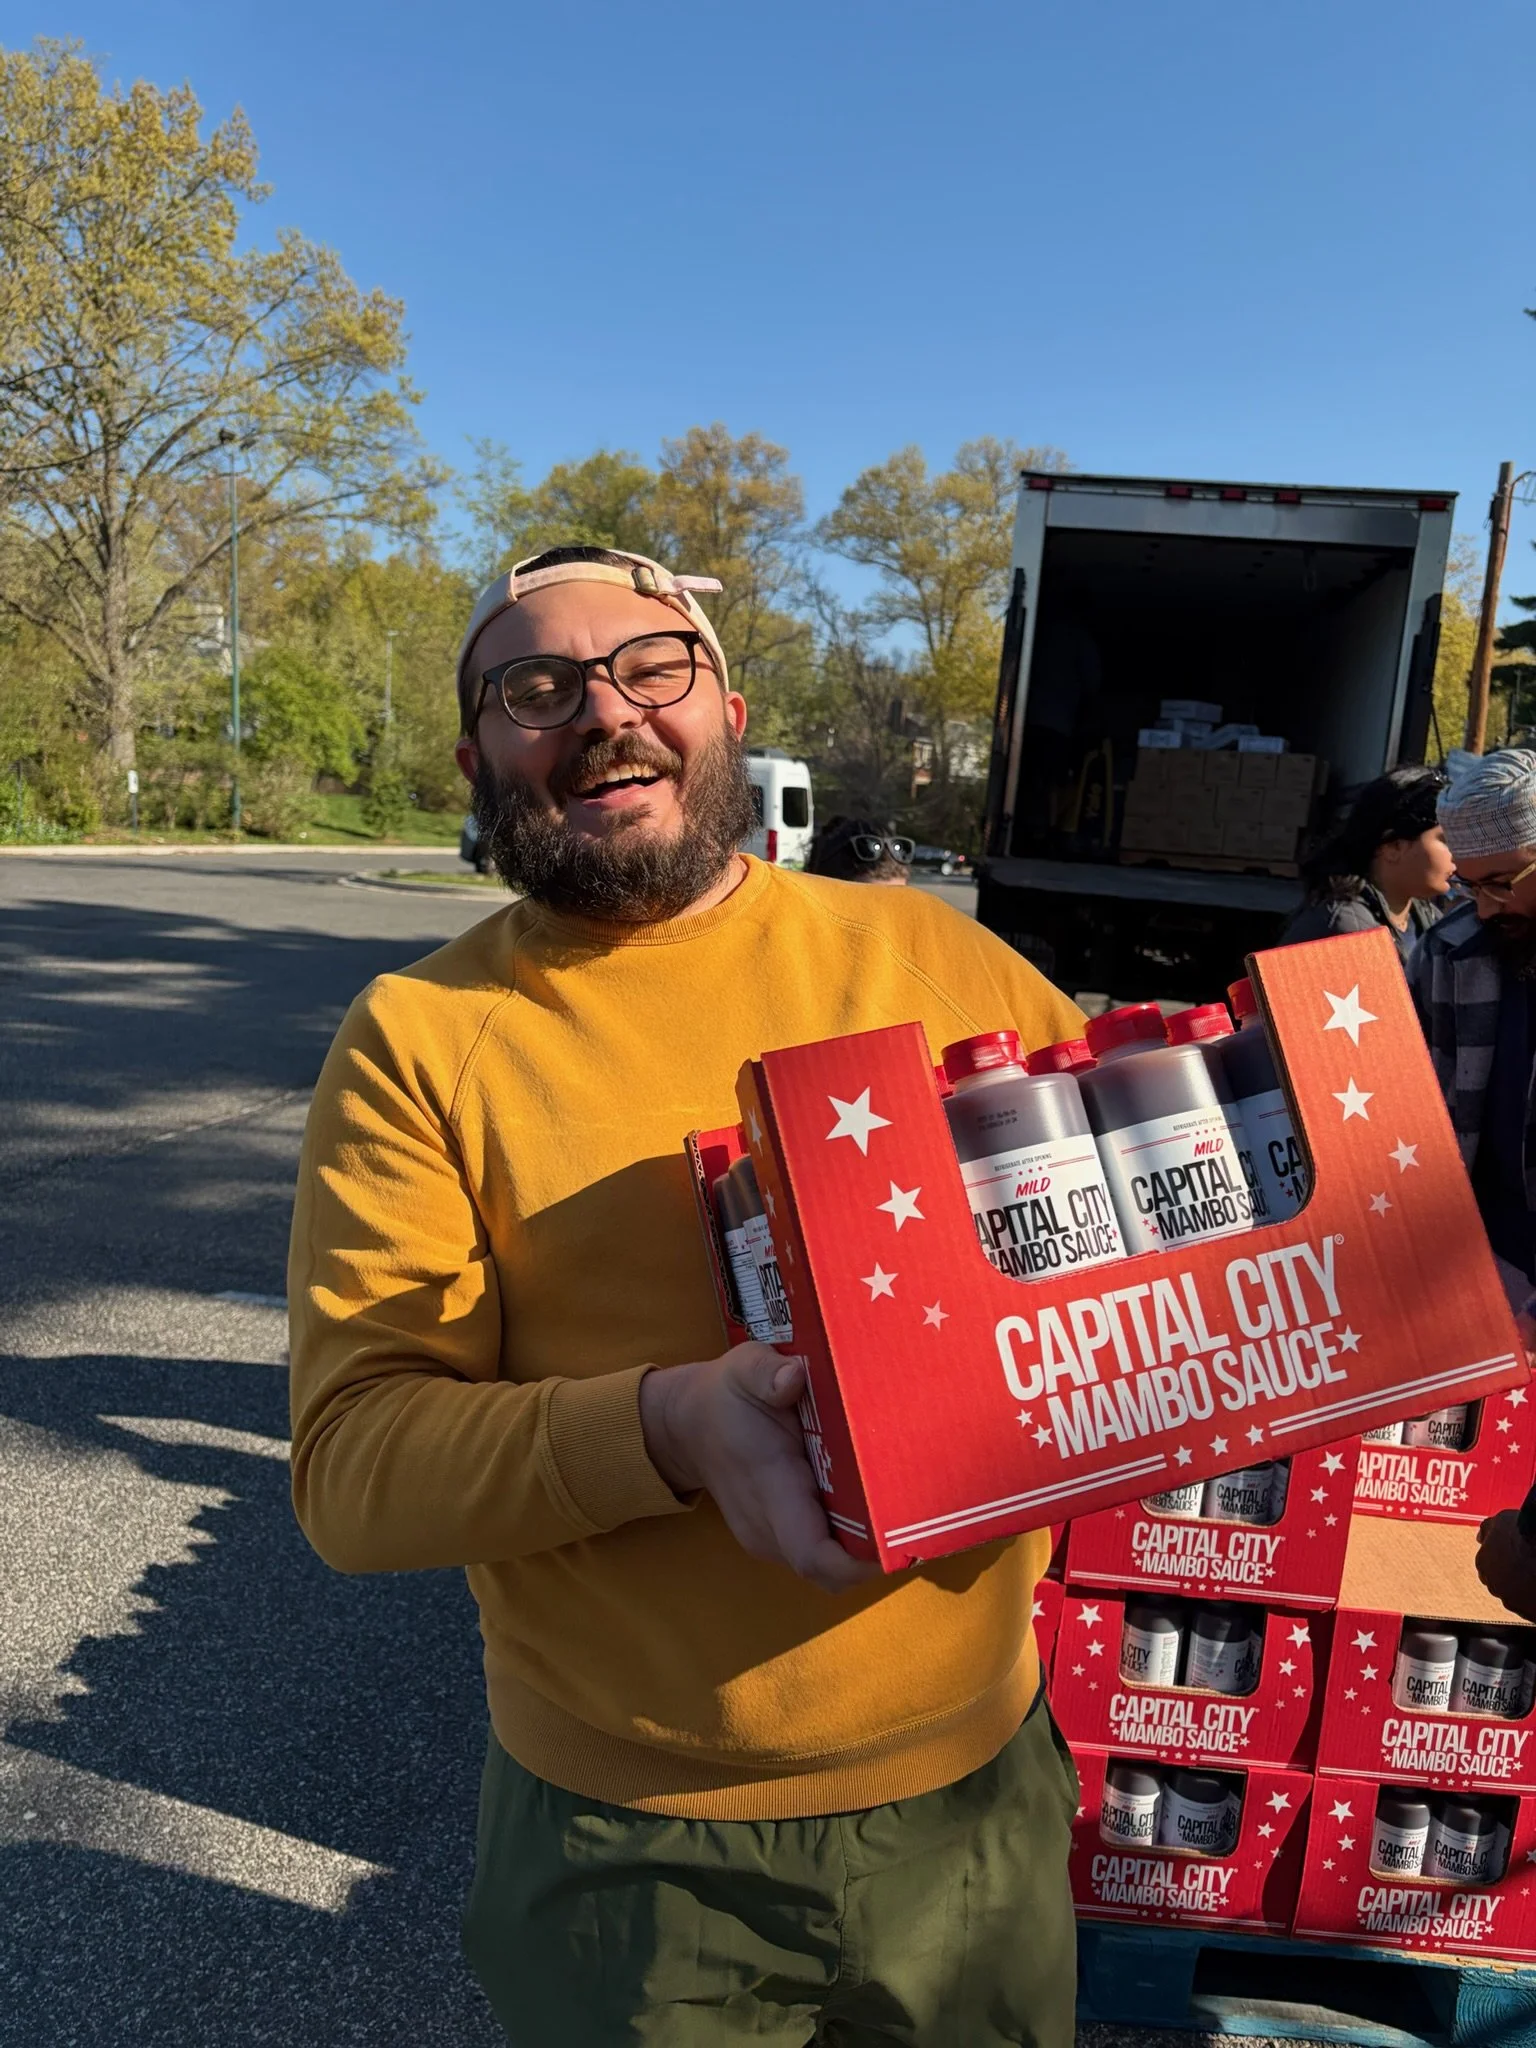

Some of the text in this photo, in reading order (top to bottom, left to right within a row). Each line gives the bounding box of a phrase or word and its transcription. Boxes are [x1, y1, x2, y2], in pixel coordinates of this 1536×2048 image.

[1194, 1138, 1224, 1157] MILD
[1015, 1176, 1051, 1198] MILD
[1130, 1155, 1243, 1216] CAPITAL
[974, 1183, 1111, 1250] APITAL CITY
[1156, 1195, 1239, 1241] MAMBO
[1061, 1224, 1116, 1264] SAUCE
[995, 1272, 1231, 1401] CAPITAL
[1046, 1321, 1347, 1460] MAMBO SAUCE
[1357, 1451, 1474, 1488] APITAL CITY
[1217, 1483, 1258, 1504] CAPITAL
[1354, 1477, 1460, 1507] MAMBO SAUCE
[1131, 1521, 1281, 1564] CAPITAL CITY
[1142, 1552, 1266, 1585] MAMBO SAUCE
[1127, 1643, 1151, 1663] CITY
[1406, 1675, 1449, 1695] CAPITAL
[1462, 1678, 1507, 1701] CAPITAL
[1109, 1693, 1255, 1734] CAPITAL CITY
[1119, 1722, 1240, 1753] MAMBO SAUCE
[1381, 1718, 1529, 1758] CAPITAL CITY
[1391, 1747, 1514, 1778] MAMBO SAUCE
[1378, 1839, 1419, 1860] CAPITAL
[1382, 1855, 1414, 1870] MAMBO
[1434, 1840, 1478, 1866] CAPITAL
[1091, 1854, 1235, 1894] CAPITAL CITY
[1438, 1857, 1471, 1876] MAMBO
[1101, 1881, 1220, 1912] MAMBO SAUCE
[1357, 1886, 1501, 1922] CAPITAL CITY
[1366, 1912, 1486, 1941] MAMBO SAUCE
